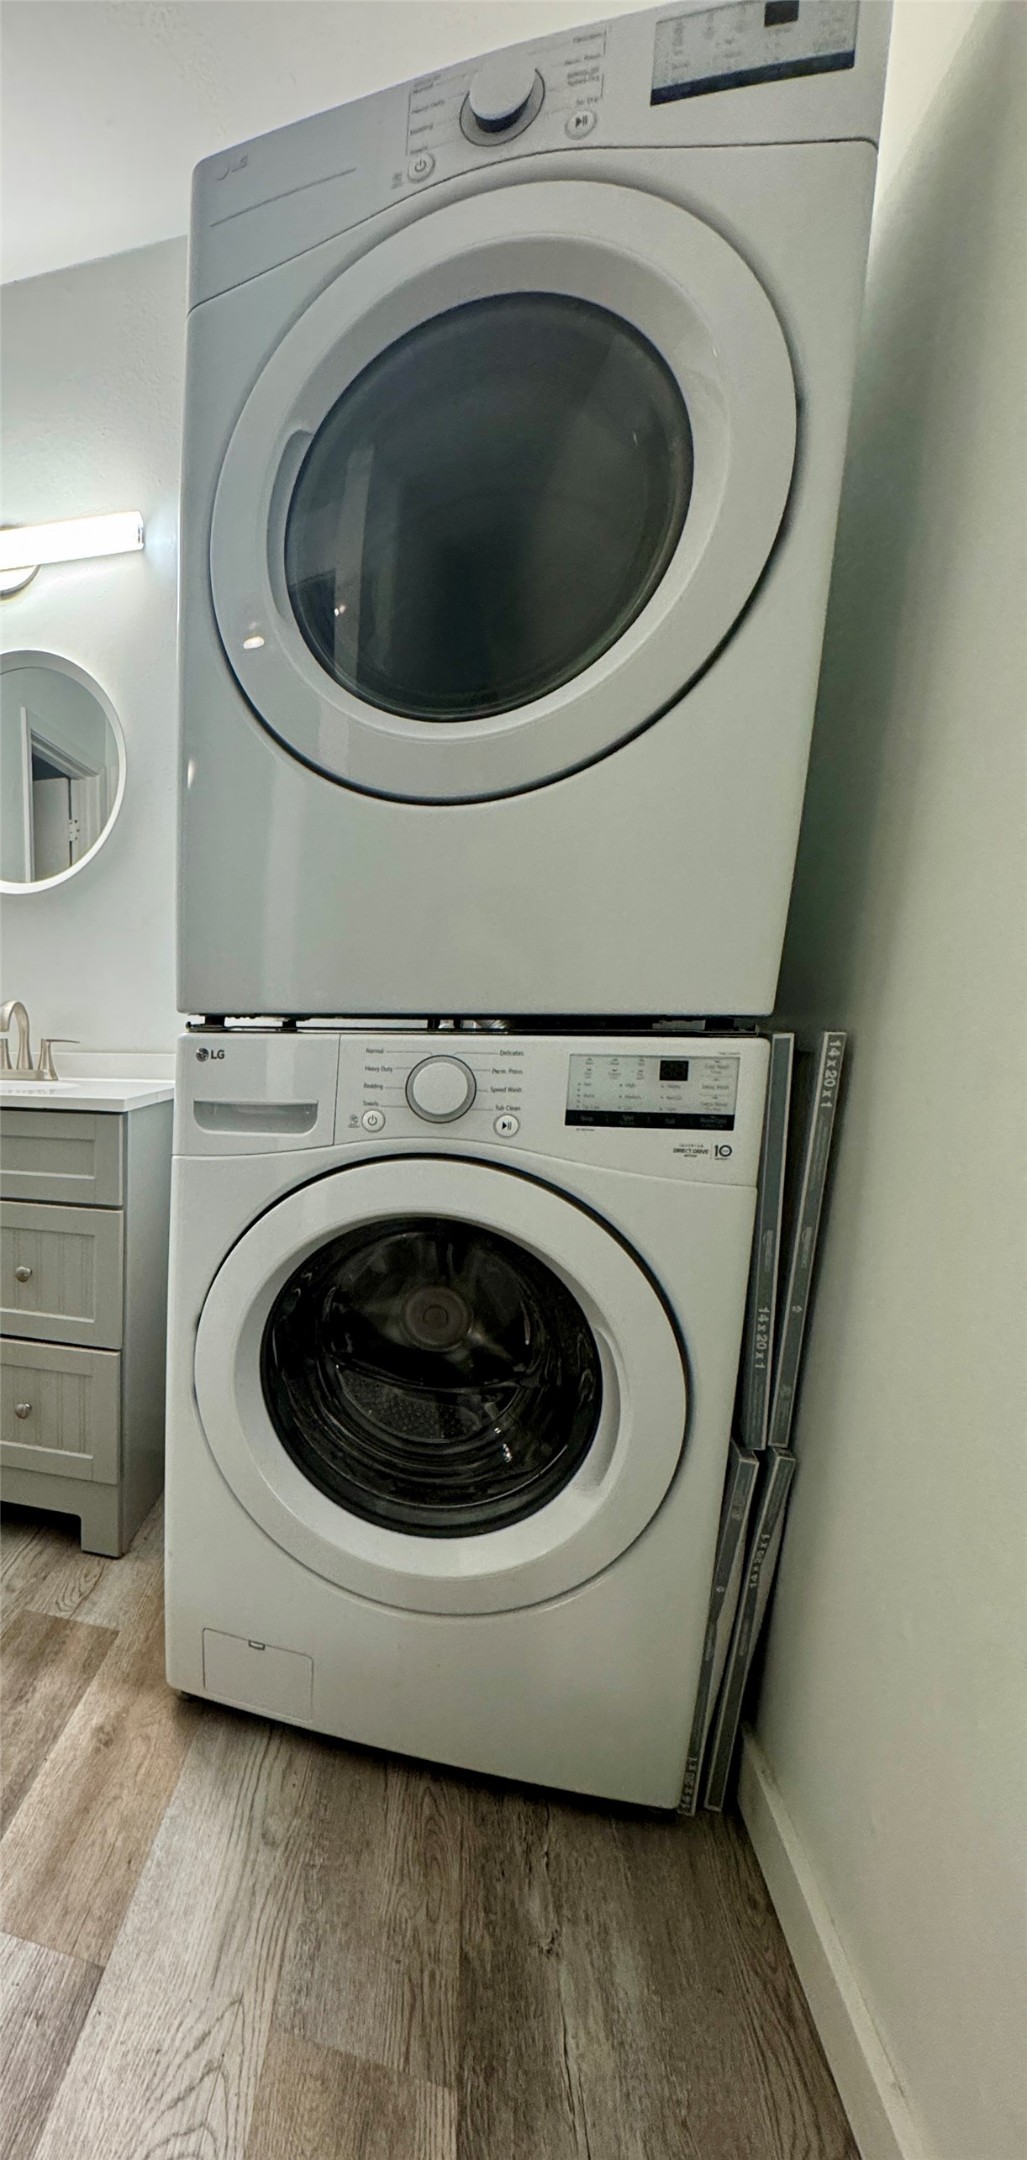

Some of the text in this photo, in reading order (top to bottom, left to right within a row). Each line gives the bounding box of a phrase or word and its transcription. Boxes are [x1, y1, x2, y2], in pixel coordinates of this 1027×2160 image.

[210, 1049, 226, 1060] LG
[500, 1049, 524, 1057] Delicates
[828, 1040, 841, 1057] 14
[364, 1064, 394, 1074] Heavy Duty
[824, 1070, 838, 1087] 20
[490, 1086, 507, 1094] Speed
[714, 1144, 733, 1158] 10
[757, 1306, 770, 1322] 14
[756, 1334, 768, 1350] 20
